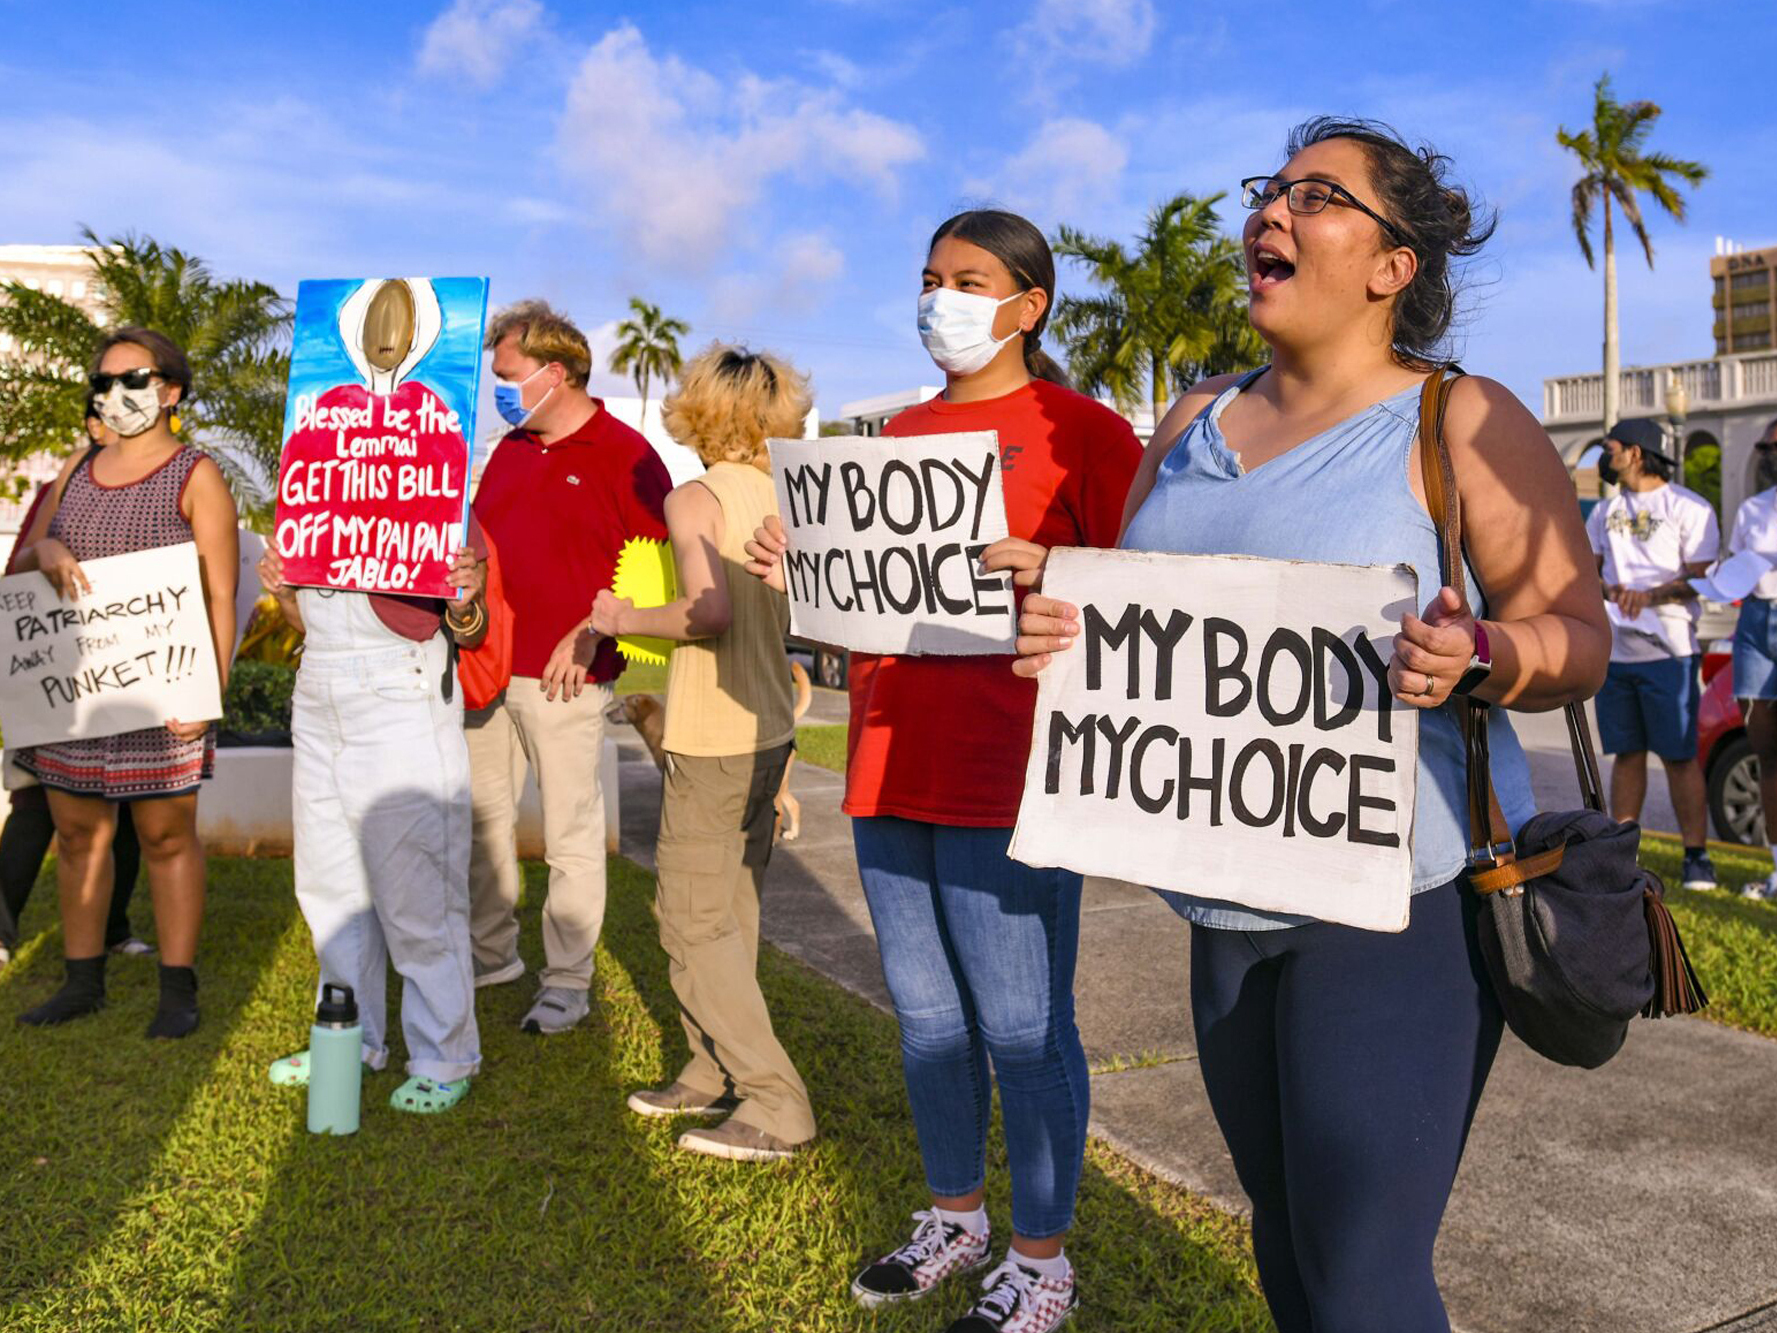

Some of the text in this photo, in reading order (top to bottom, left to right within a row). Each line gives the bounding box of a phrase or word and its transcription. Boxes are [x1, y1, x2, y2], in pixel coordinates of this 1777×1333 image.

[295, 391, 463, 433] Blessed be the
[336, 429, 417, 460] Lemmai
[397, 463, 459, 501] BILL
[784, 452, 995, 541] MY BODY
[276, 511, 330, 558] OFF
[332, 515, 376, 557] MY
[327, 555, 422, 590] JABLO!
[15, 586, 188, 642] PATRIARCHY
[9, 619, 174, 676] AWAY FROM MY
[1083, 603, 1393, 743] MY BODY
